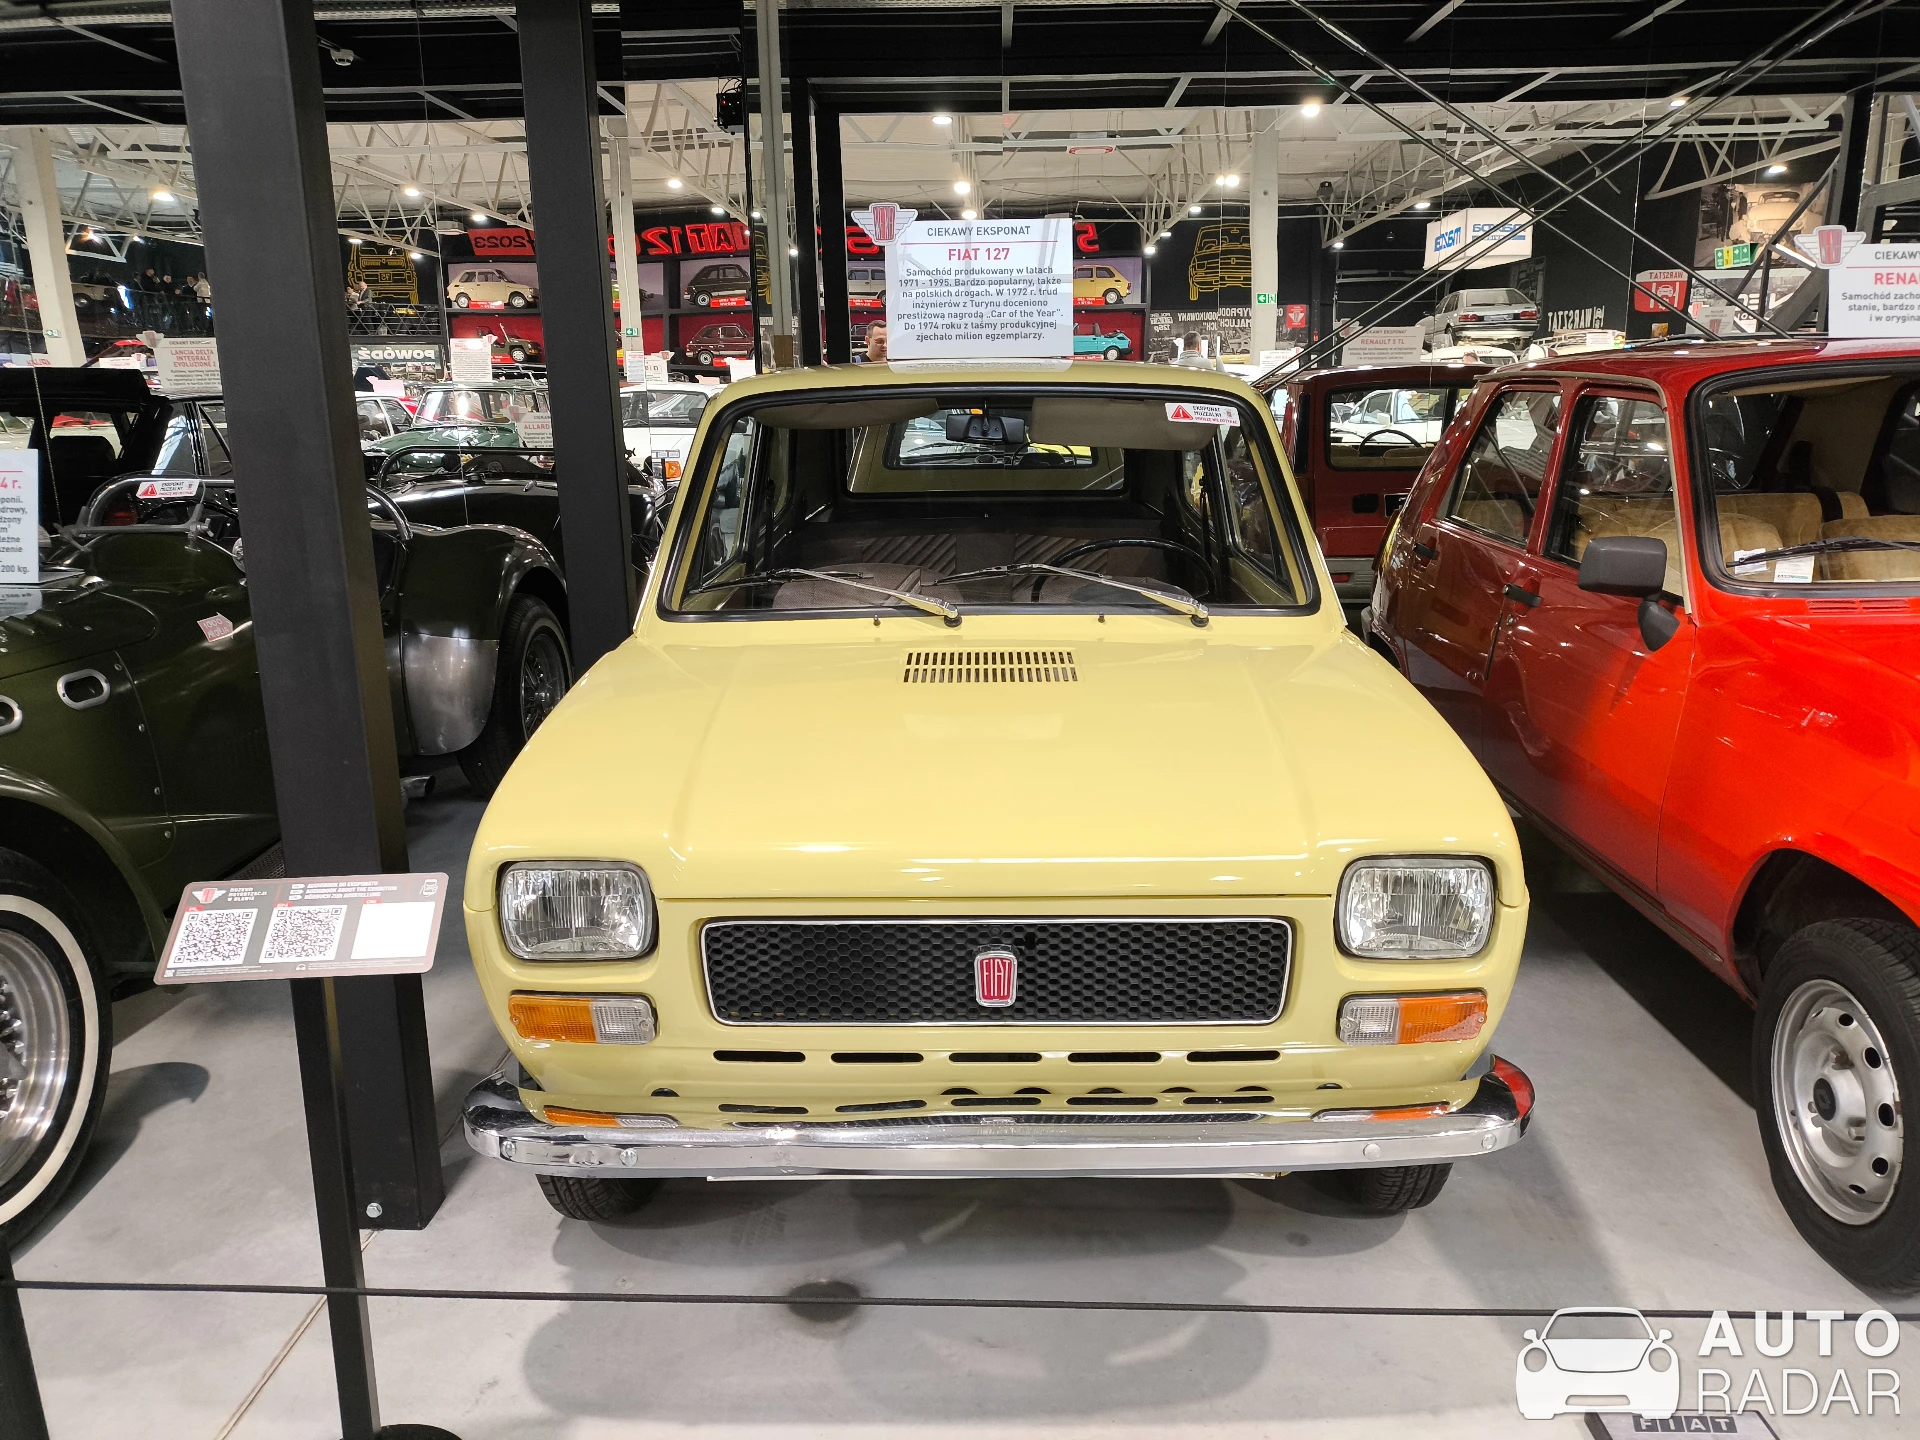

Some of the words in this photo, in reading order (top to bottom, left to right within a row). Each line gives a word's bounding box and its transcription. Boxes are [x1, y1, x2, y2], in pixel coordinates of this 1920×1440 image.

[927, 227, 974, 236] CIEKAWY
[976, 226, 1030, 235] EKSPONAT
[948, 248, 980, 261] FIAT
[985, 248, 1010, 261] 127
[906, 267, 952, 276] Samochód
[954, 267, 1014, 277] produkowany
[1026, 266, 1053, 274] latach
[899, 279, 919, 287] 1971
[928, 279, 951, 287] 1995.
[954, 278, 986, 287] Bardzo
[988, 278, 1035, 287] popularny,
[1037, 276, 1062, 285] także
[1874, 272, 1920, 285] RENA
[915, 289, 953, 299] polskich
[955, 289, 993, 298] drogach.
[1007, 288, 1028, 296] 1972
[1842, 291, 1891, 300] Samochód
[912, 299, 960, 310] inżynierów
[970, 299, 1000, 309] Turynu
[1003, 299, 1048, 307] doceniono
[1848, 302, 1880, 312] stanie,
[1882, 302, 1915, 311] bardzo
[897, 311, 946, 321] prestiżową
[948, 311, 984, 320] nagrodą
[1009, 310, 1018, 318] of
[1020, 310, 1034, 318] the
[904, 322, 916, 330] Do
[919, 321, 939, 330] 1974
[942, 321, 962, 330] roku
[971, 320, 998, 330] taśmy
[1000, 320, 1057, 330] produkcyjnej
[916, 333, 953, 342] zjechało
[955, 332, 983, 340] milion
[985, 331, 1045, 341] egzemplarzy.
[12, 480, 21, 489] r.
[1, 565, 15, 573] 200
[18, 565, 29, 575] kg.
[203, 618, 223, 629] 1000
[983, 959, 1011, 997] FIAT
[1639, 1416, 1730, 1433] FIAT
